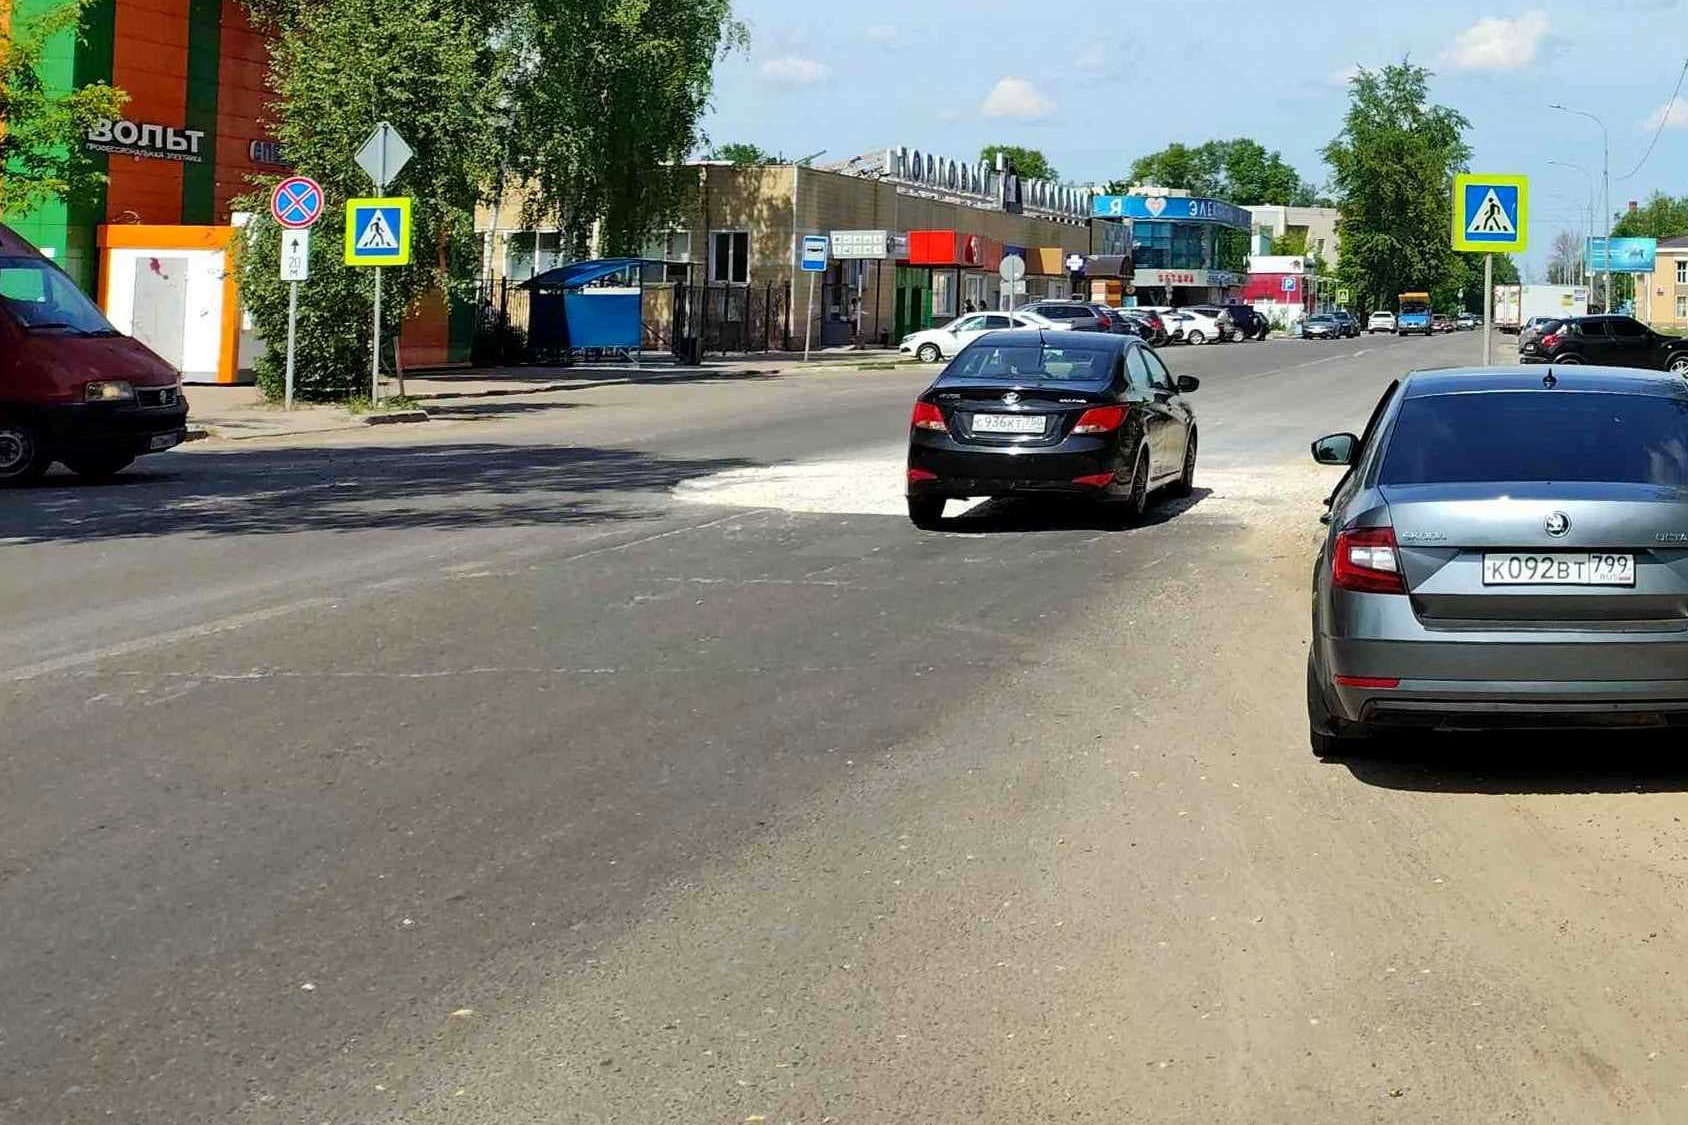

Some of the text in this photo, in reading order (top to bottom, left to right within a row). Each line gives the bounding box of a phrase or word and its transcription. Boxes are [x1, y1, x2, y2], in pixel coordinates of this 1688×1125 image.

[88, 119, 204, 153] ВОЛЬТ
[1492, 555, 1628, 580] К092ВТ 799
